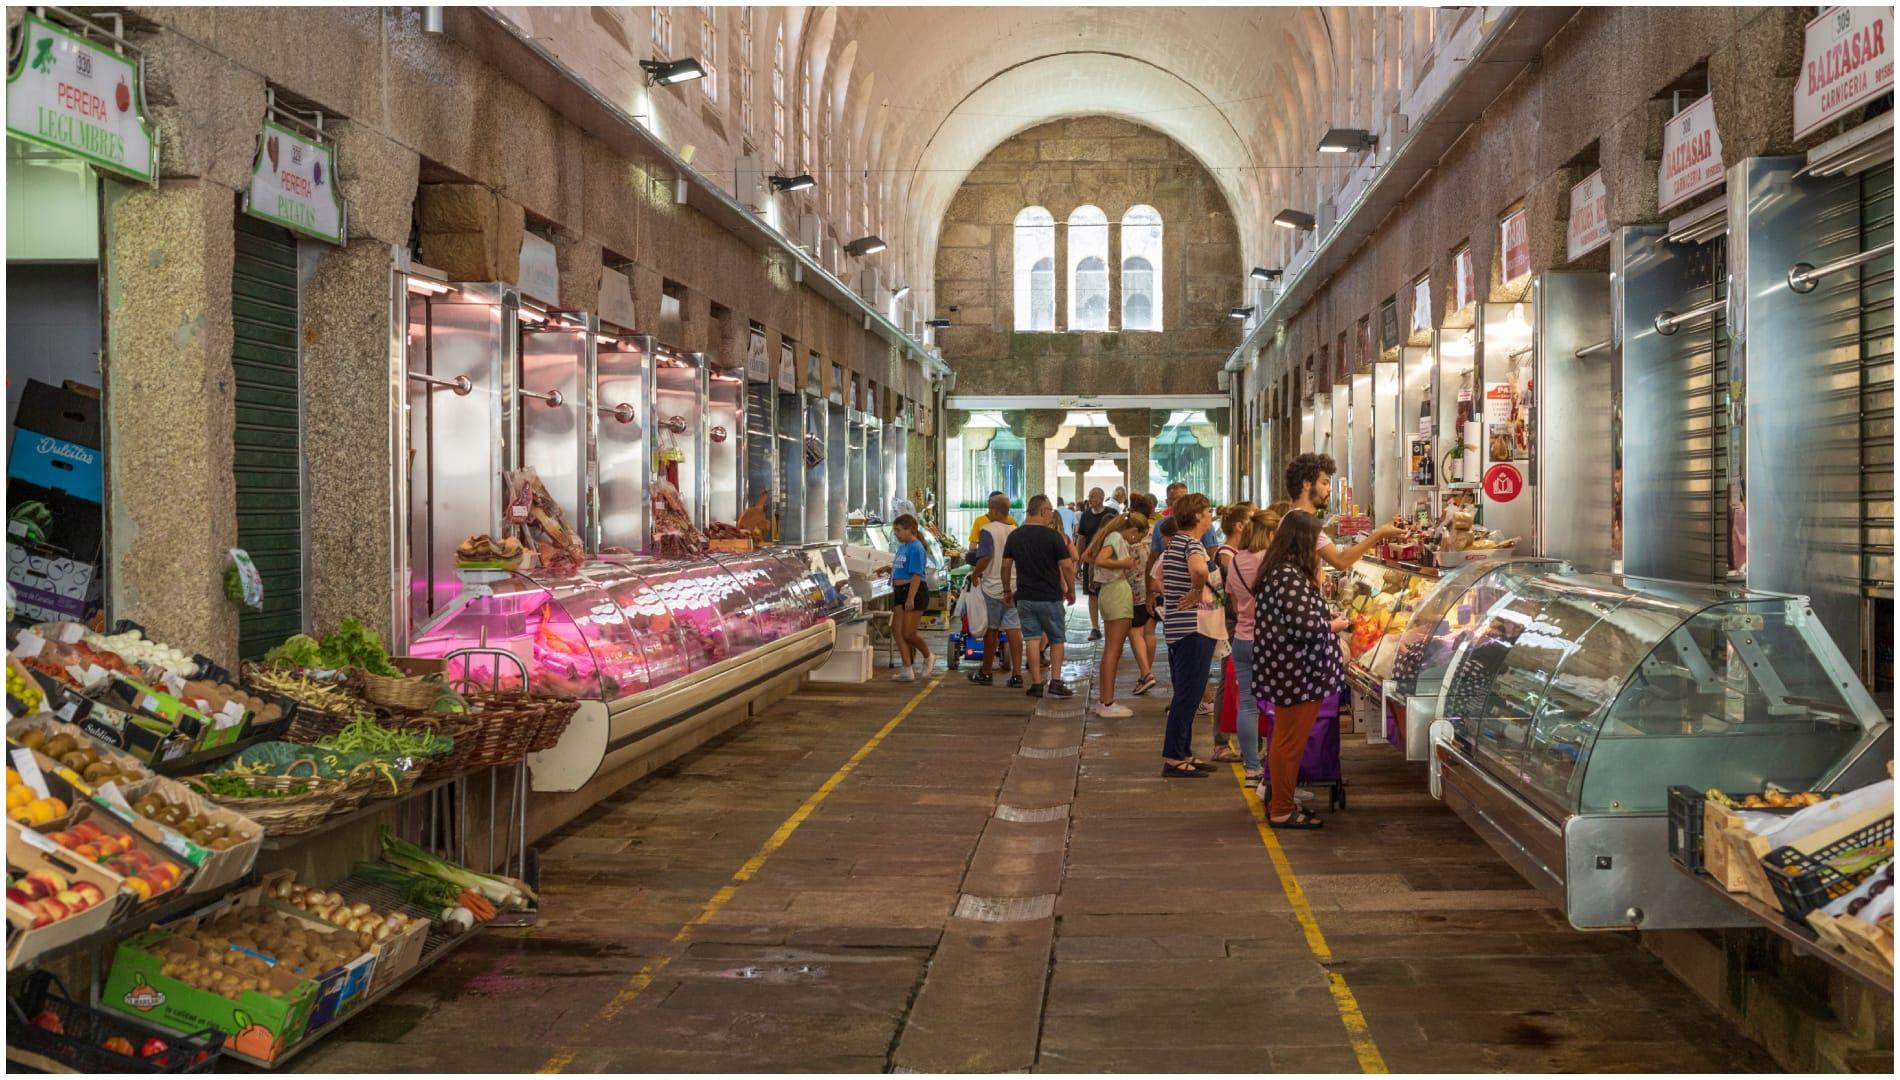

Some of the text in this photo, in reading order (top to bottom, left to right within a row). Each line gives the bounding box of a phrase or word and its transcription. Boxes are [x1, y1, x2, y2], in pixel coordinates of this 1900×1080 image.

[1837, 9, 1850, 34] 309
[78, 54, 92, 74] 330
[1808, 18, 1885, 97] BALTASAR
[58, 82, 107, 123] PEREIRA
[1821, 71, 1867, 113] CARNICERIA
[38, 106, 125, 162] LEGUMBRES
[1664, 129, 1712, 181] BALTASAR
[281, 170, 313, 200] PEREIRA
[1674, 168, 1702, 195] CARNICERIA
[277, 193, 316, 226] PATATAS
[36, 437, 94, 466] Dulcitas
[84, 723, 117, 746] Sublime
